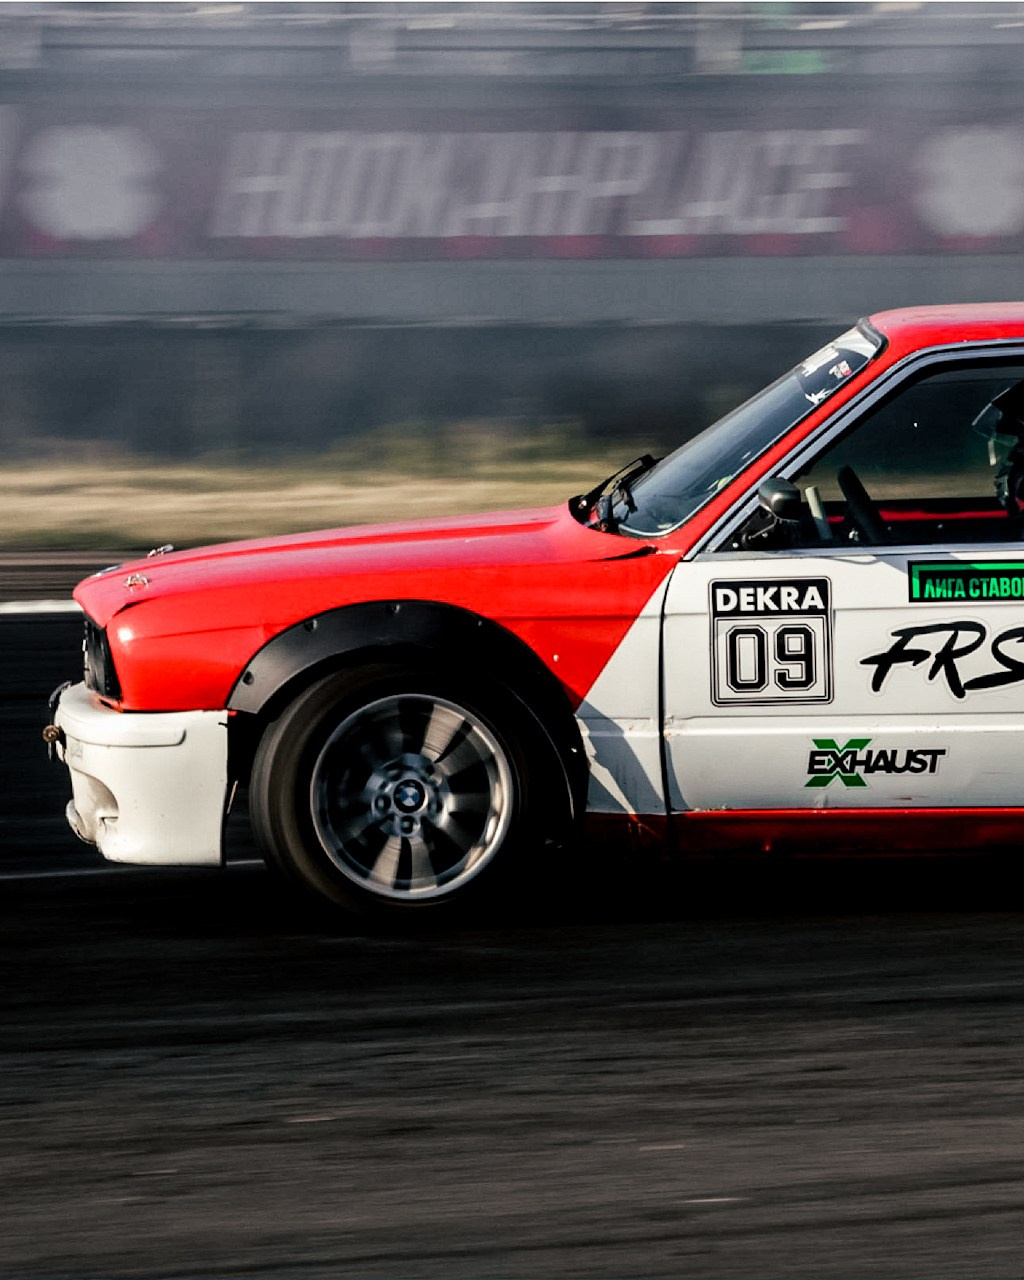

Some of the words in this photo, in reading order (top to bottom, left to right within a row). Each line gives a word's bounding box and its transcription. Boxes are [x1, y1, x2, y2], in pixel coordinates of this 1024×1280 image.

[716, 586, 825, 612] DEKRA
[924, 578, 966, 598] ЛИГА
[726, 623, 817, 693] 09
[803, 738, 946, 787] EXHAUST
